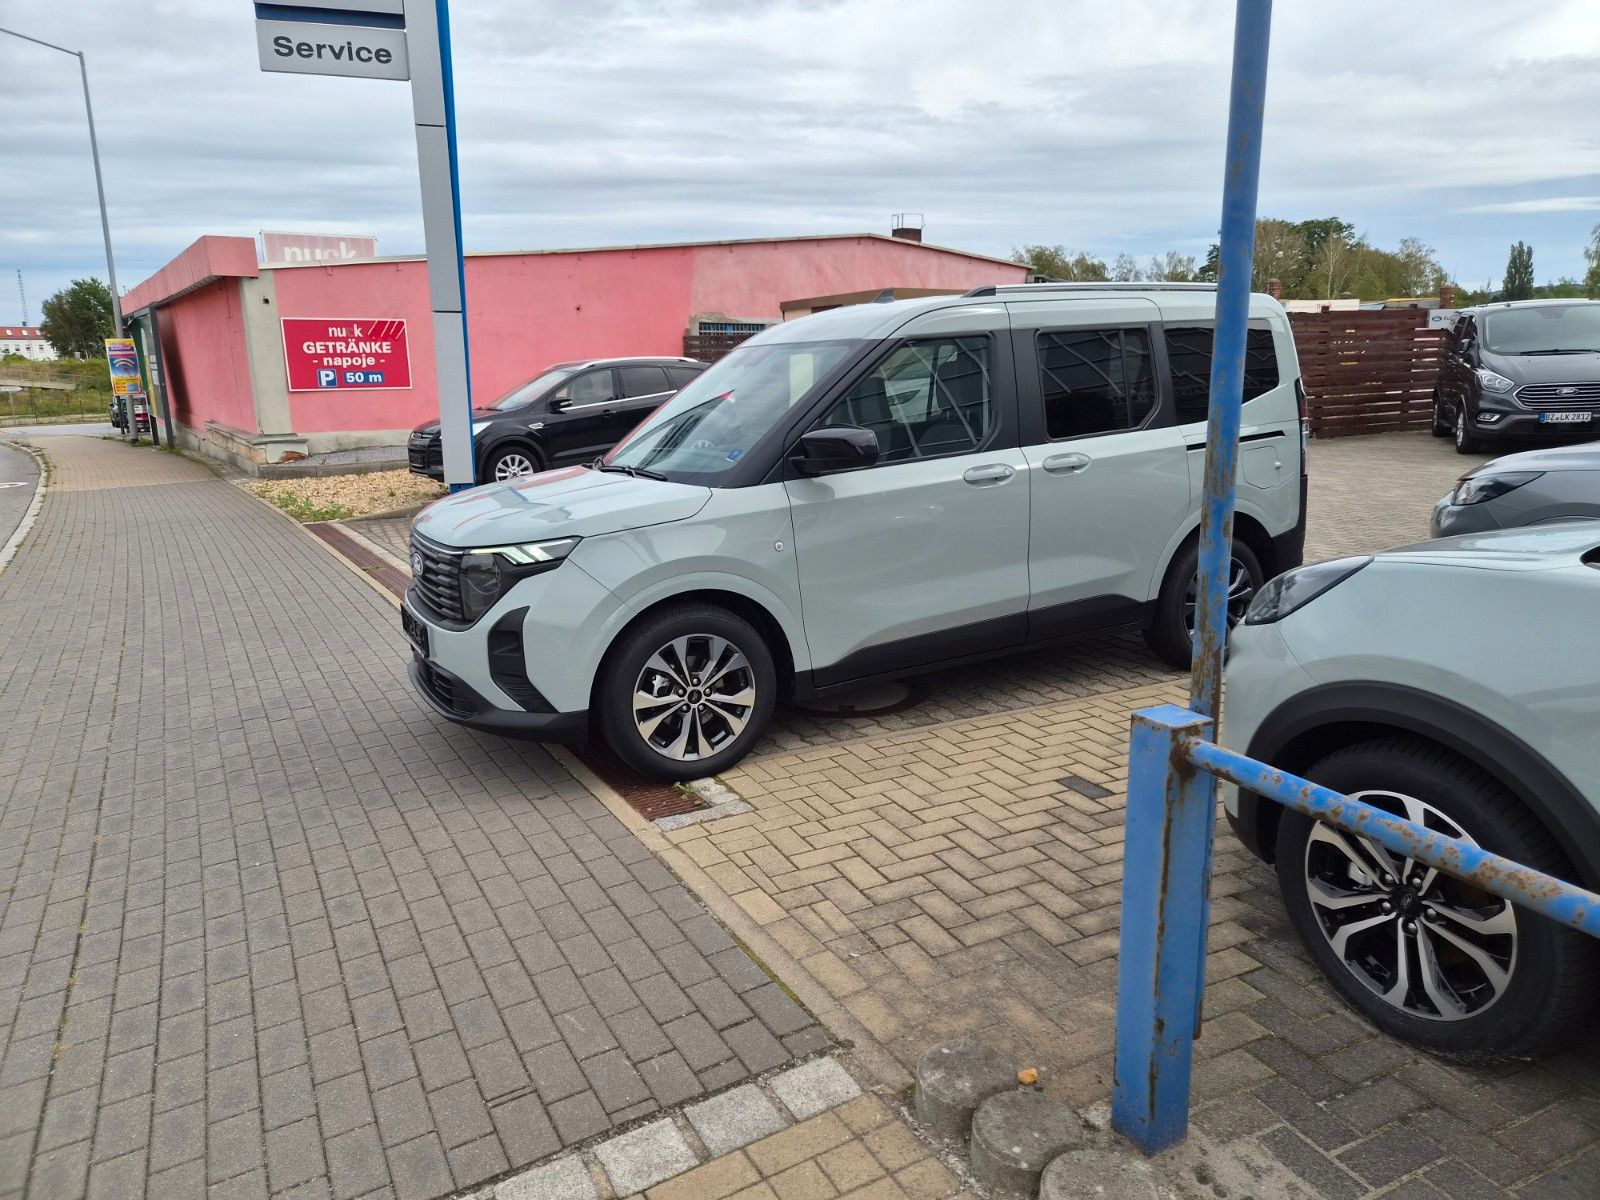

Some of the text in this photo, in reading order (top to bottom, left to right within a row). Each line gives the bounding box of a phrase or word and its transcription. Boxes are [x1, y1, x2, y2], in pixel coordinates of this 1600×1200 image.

[273, 35, 392, 64] Service
[328, 323, 363, 337] nuk
[303, 338, 391, 354] GETRÄNKE
[323, 354, 375, 368] napoje
[320, 370, 382, 386] P 50 m
